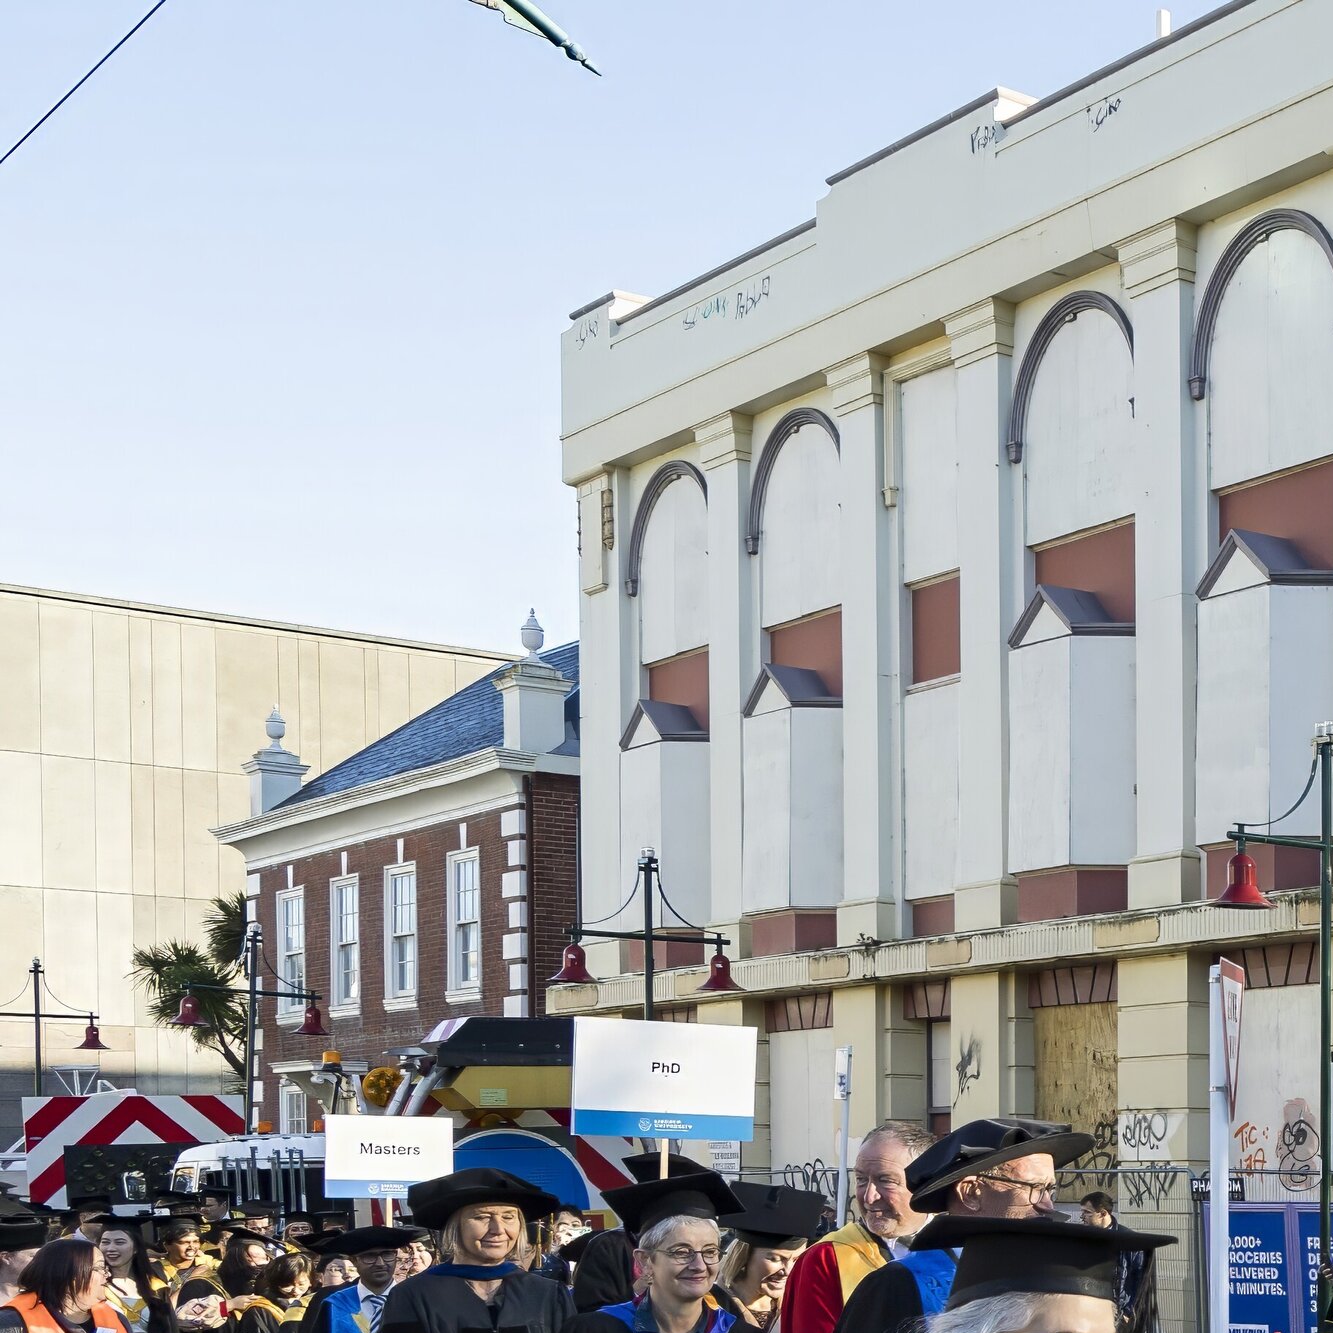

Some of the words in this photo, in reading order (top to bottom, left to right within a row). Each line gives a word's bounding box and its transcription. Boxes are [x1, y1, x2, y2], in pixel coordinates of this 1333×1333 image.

[651, 1062, 681, 1074] PhD
[359, 1142, 421, 1156] Masters
[1229, 1252, 1283, 1264] ROCERIES
[1229, 1267, 1279, 1280] ELIVERED
[1236, 1283, 1286, 1296] MINUTES.
